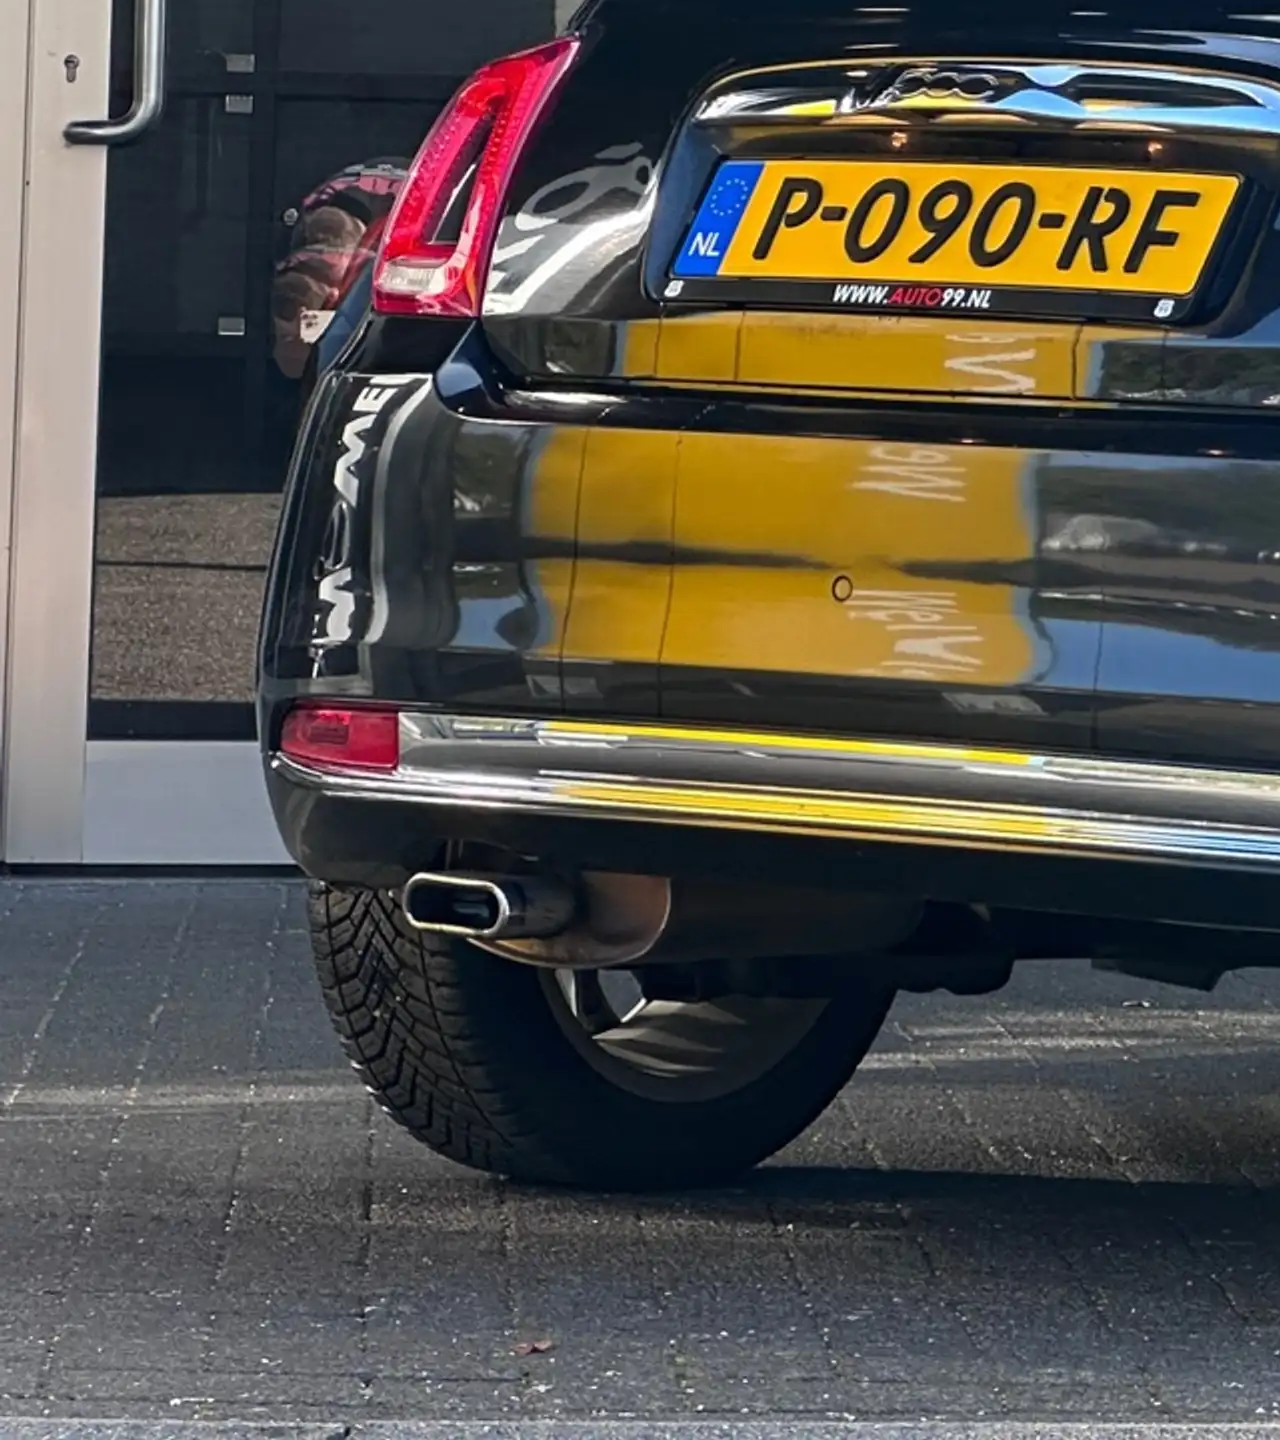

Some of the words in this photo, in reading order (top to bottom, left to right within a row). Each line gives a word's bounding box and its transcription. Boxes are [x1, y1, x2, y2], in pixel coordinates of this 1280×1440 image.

[752, 176, 1200, 274] P-090-RF
[688, 231, 720, 257] NL
[833, 283, 992, 309] WWW.AUTO99.NL
